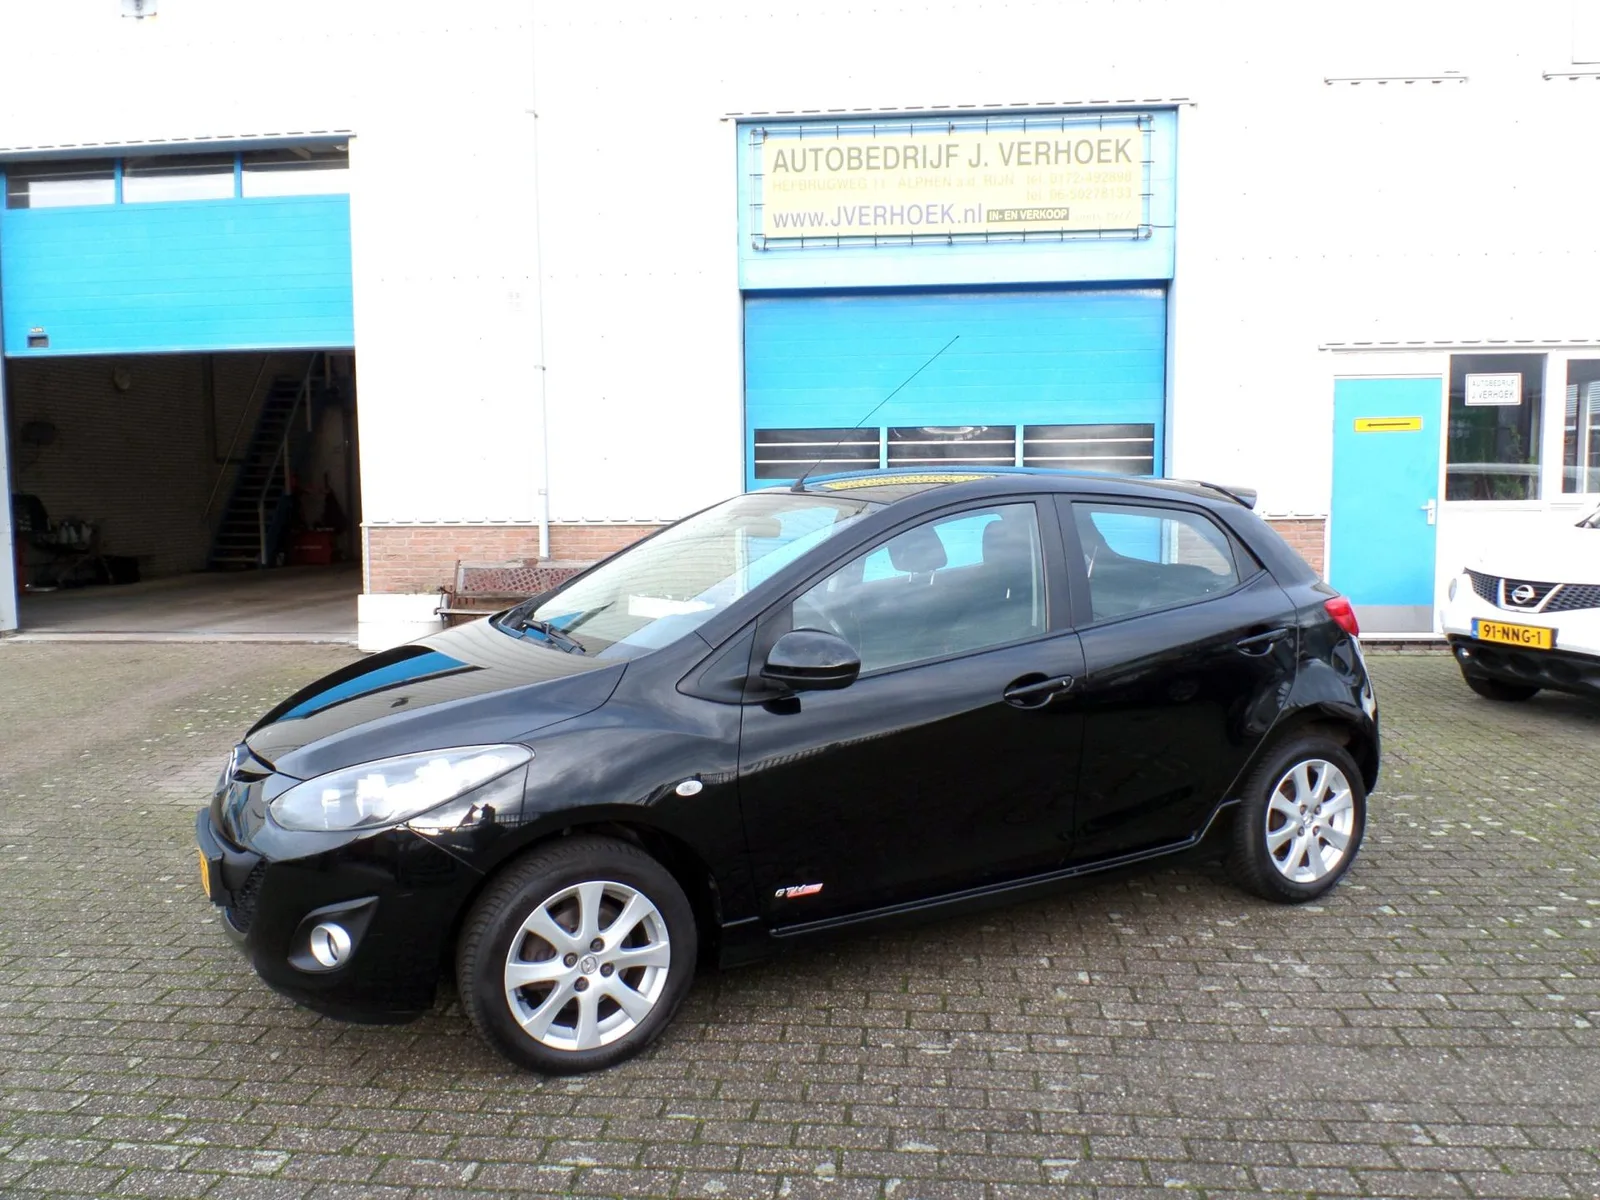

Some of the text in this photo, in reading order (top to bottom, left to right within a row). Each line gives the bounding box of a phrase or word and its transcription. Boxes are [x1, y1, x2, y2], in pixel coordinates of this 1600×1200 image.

[772, 139, 1132, 173] AUTOBEDRIJF J. VERHOEK
[772, 203, 982, 228] www.JVERHOEK.nl
[1004, 209, 1018, 221] EN
[1019, 208, 1068, 220] VERKOOP
[1483, 624, 1541, 645] 91-NNG-1
